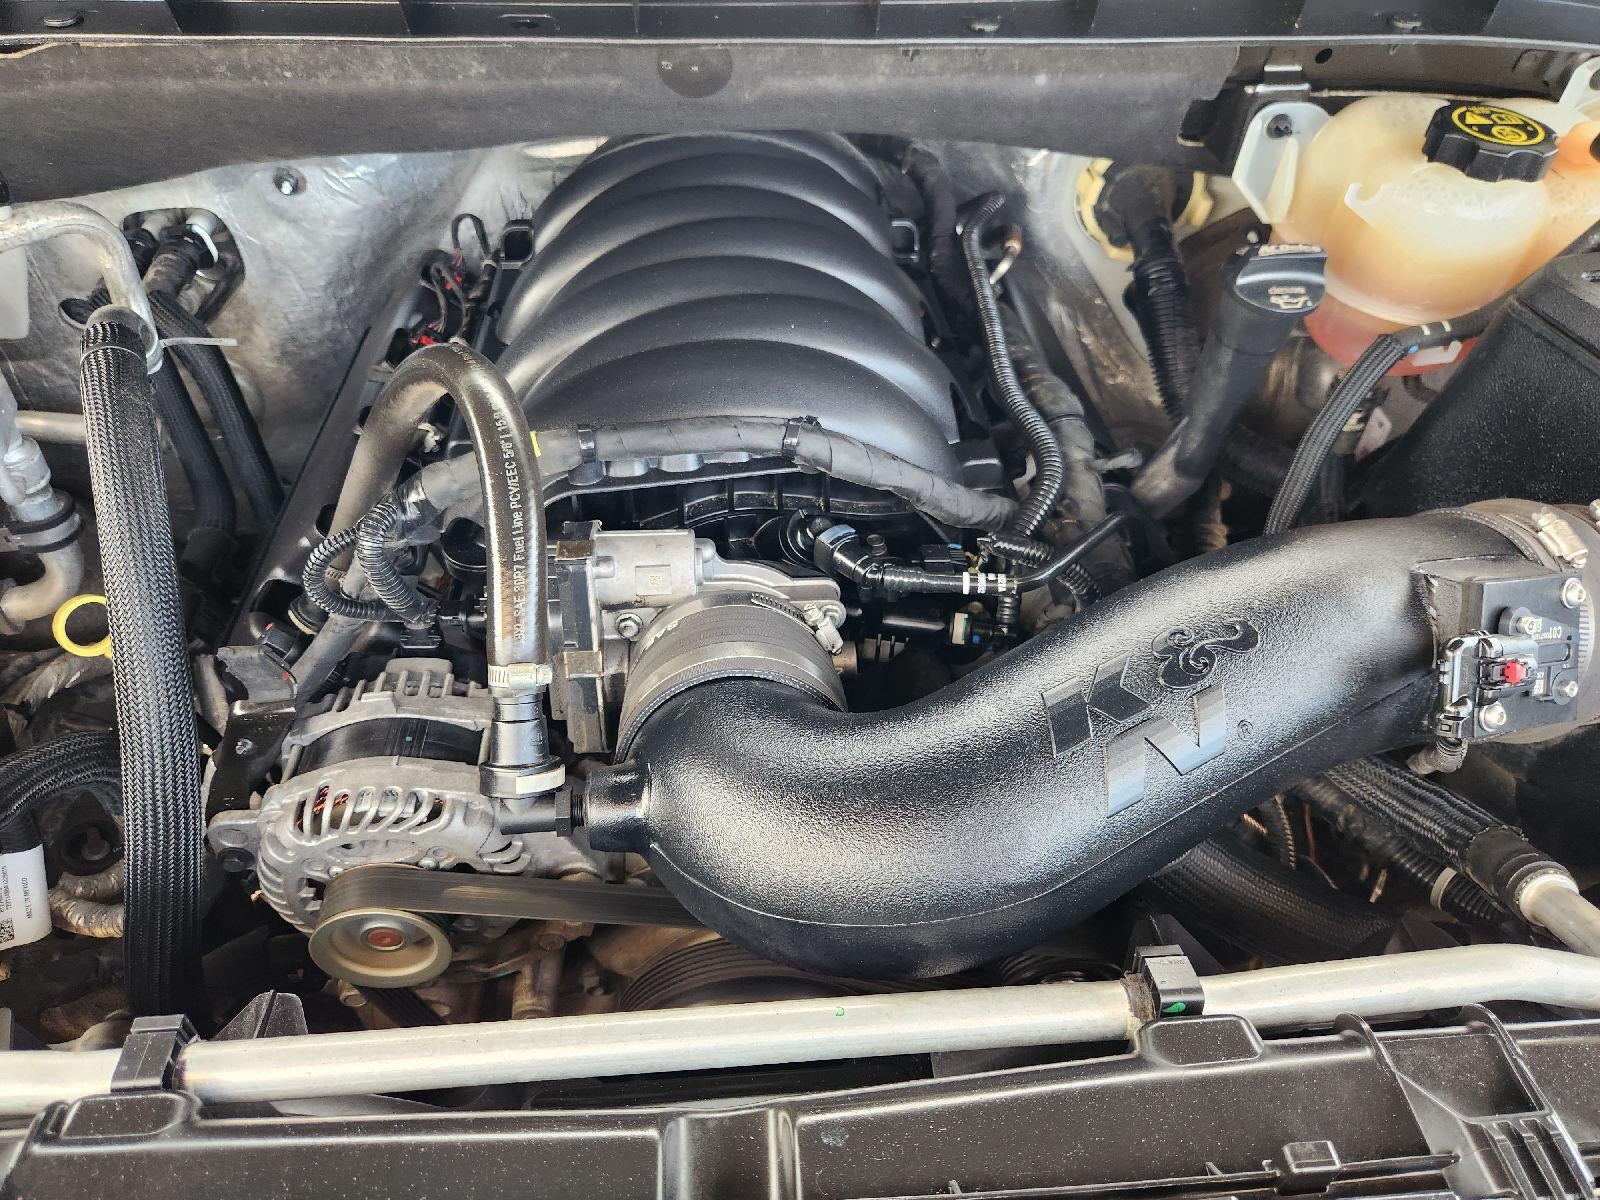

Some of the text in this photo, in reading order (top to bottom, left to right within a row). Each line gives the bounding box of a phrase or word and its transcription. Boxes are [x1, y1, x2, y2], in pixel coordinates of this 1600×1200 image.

[504, 460, 523, 510] PCV/EEC
[511, 511, 524, 535] Line
[512, 537, 526, 562] Fuel
[513, 595, 527, 618] SAE
[1041, 619, 1259, 819] K&N
